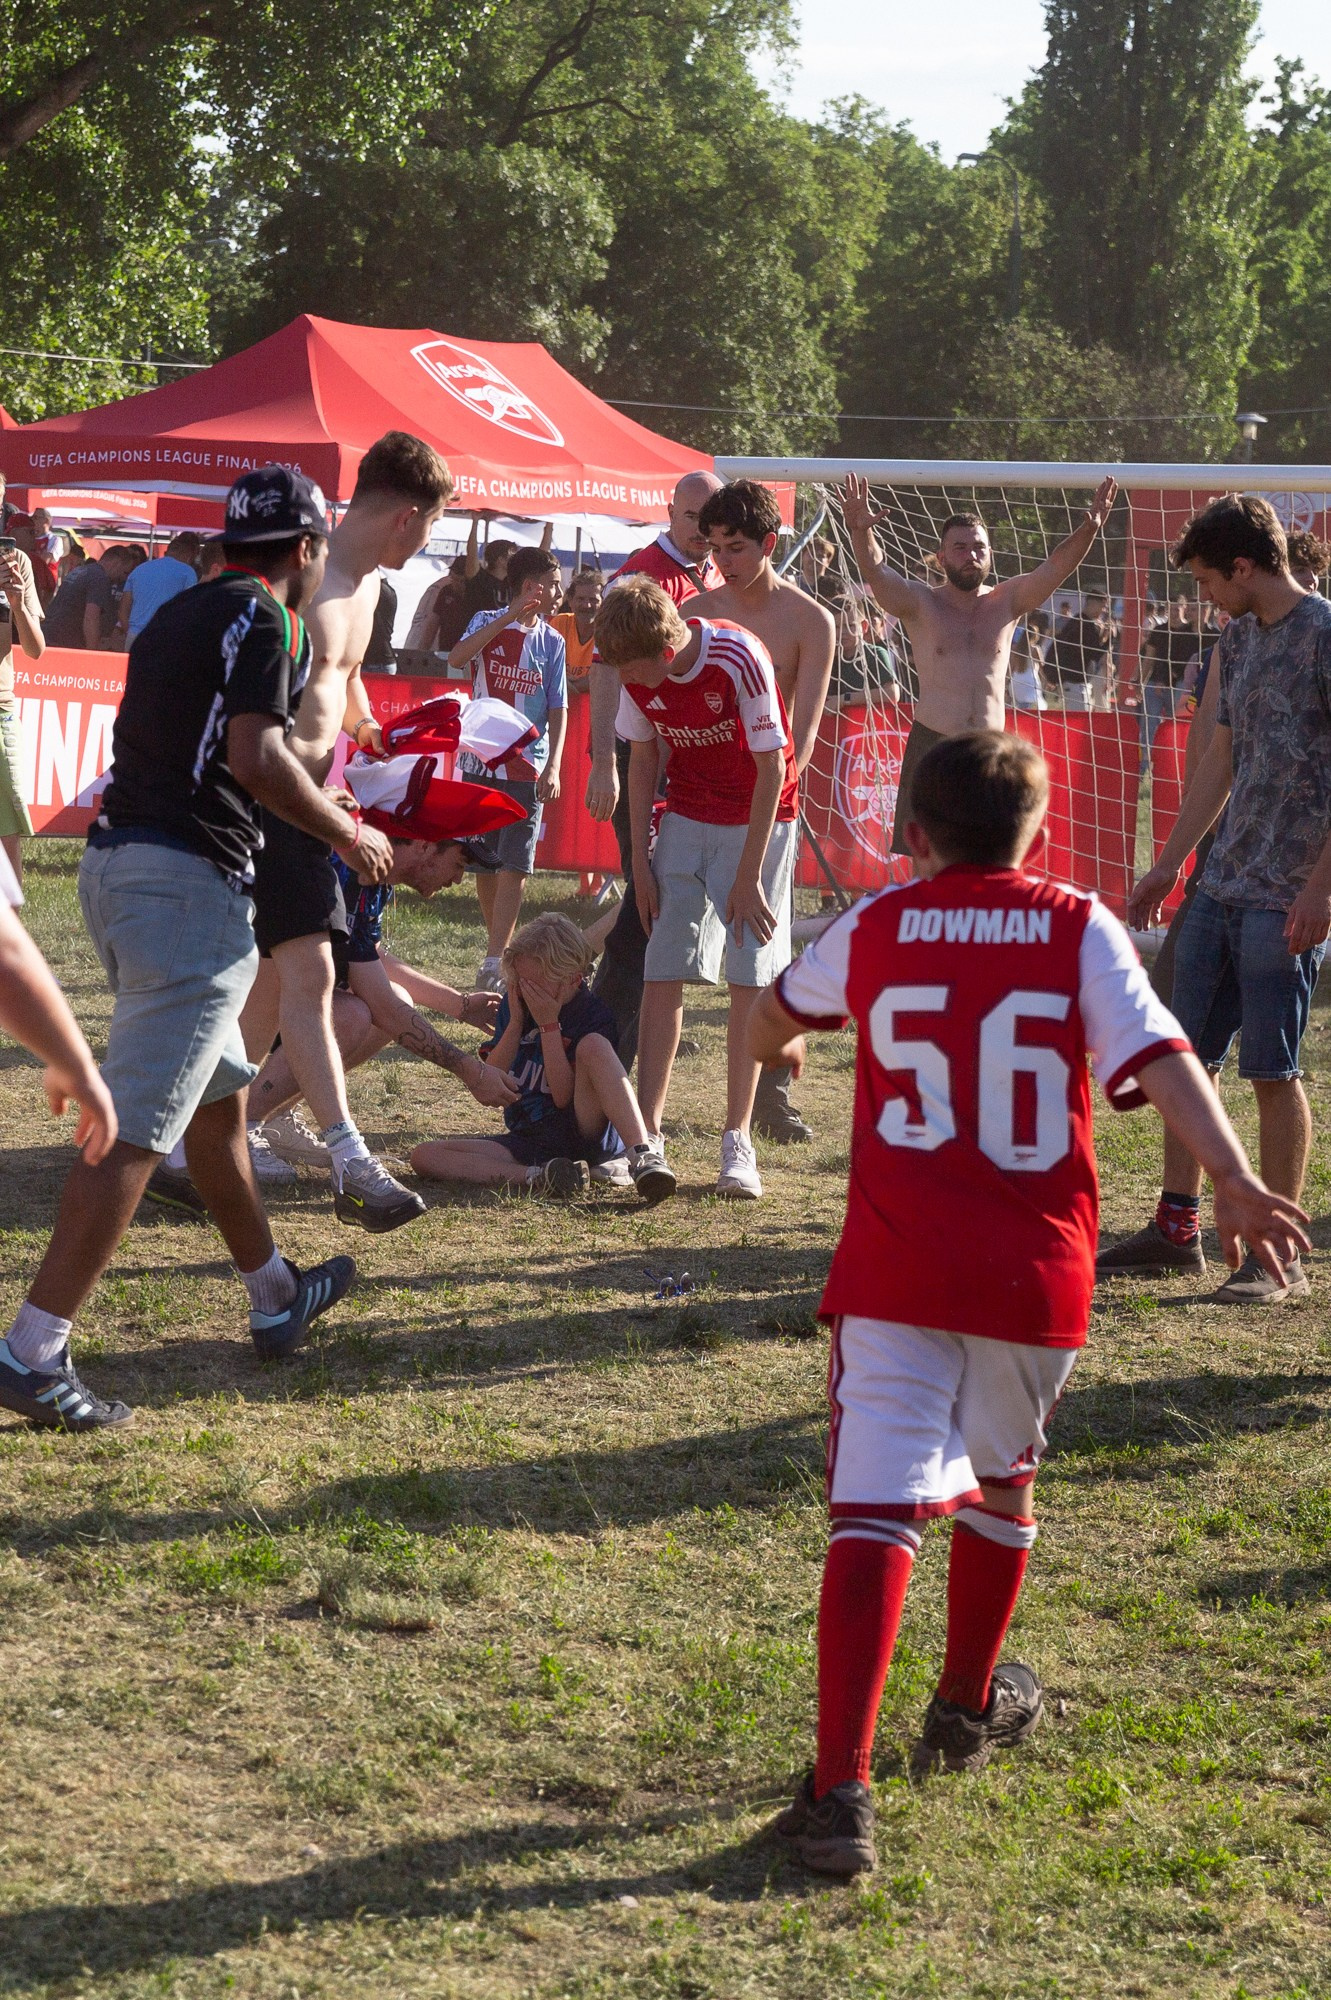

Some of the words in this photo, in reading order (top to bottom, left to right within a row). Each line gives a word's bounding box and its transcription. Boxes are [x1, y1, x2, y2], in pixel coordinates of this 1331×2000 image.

[29, 453, 62, 468] UEFA
[68, 450, 151, 465] CHAMPIONS
[156, 450, 211, 466] LEAGUE
[217, 454, 258, 471] FINAL
[41, 489, 58, 498] UEFA
[93, 490, 115, 502] LEAGUE
[115, 495, 132, 507] FINAL
[229, 488, 250, 519] NY
[490, 480, 572, 499] CHAMPIONS
[576, 480, 628, 503] LEAGUE
[630, 488, 668, 507] FINAL
[12, 671, 30, 685] EFA
[33, 673, 101, 691] CHAMPIONS
[494, 677, 509, 690] FLY
[509, 680, 537, 696] BETTER
[673, 737, 691, 749] FLY
[694, 731, 734, 748] BETTER
[851, 753, 902, 775] Arse
[897, 907, 1052, 944] DOWMAN
[868, 985, 1072, 1173] 56
